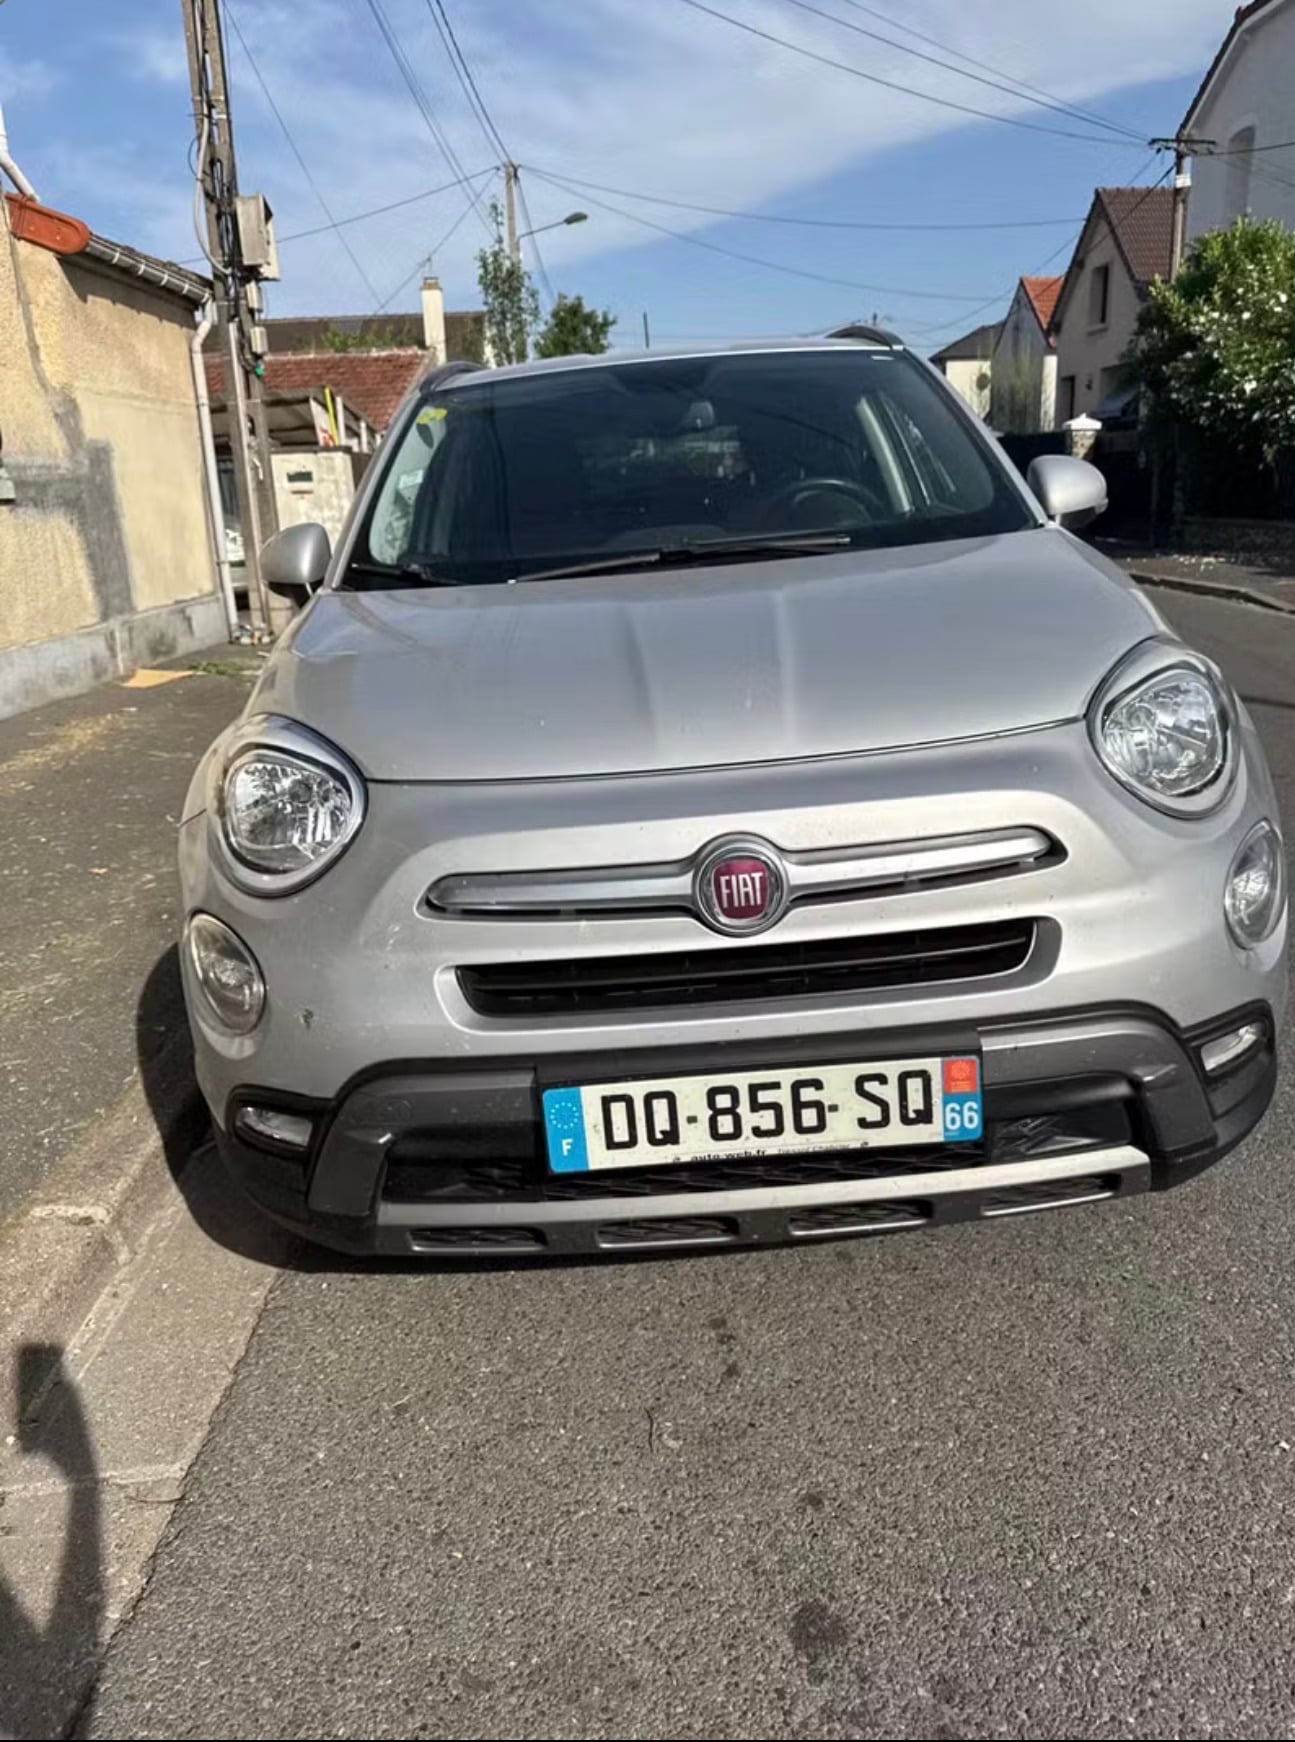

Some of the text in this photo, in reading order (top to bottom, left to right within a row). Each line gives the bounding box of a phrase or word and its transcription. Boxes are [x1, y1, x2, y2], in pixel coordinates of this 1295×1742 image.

[719, 872, 763, 909] FIAT
[945, 1101, 979, 1131] 66
[561, 1140, 573, 1156] F
